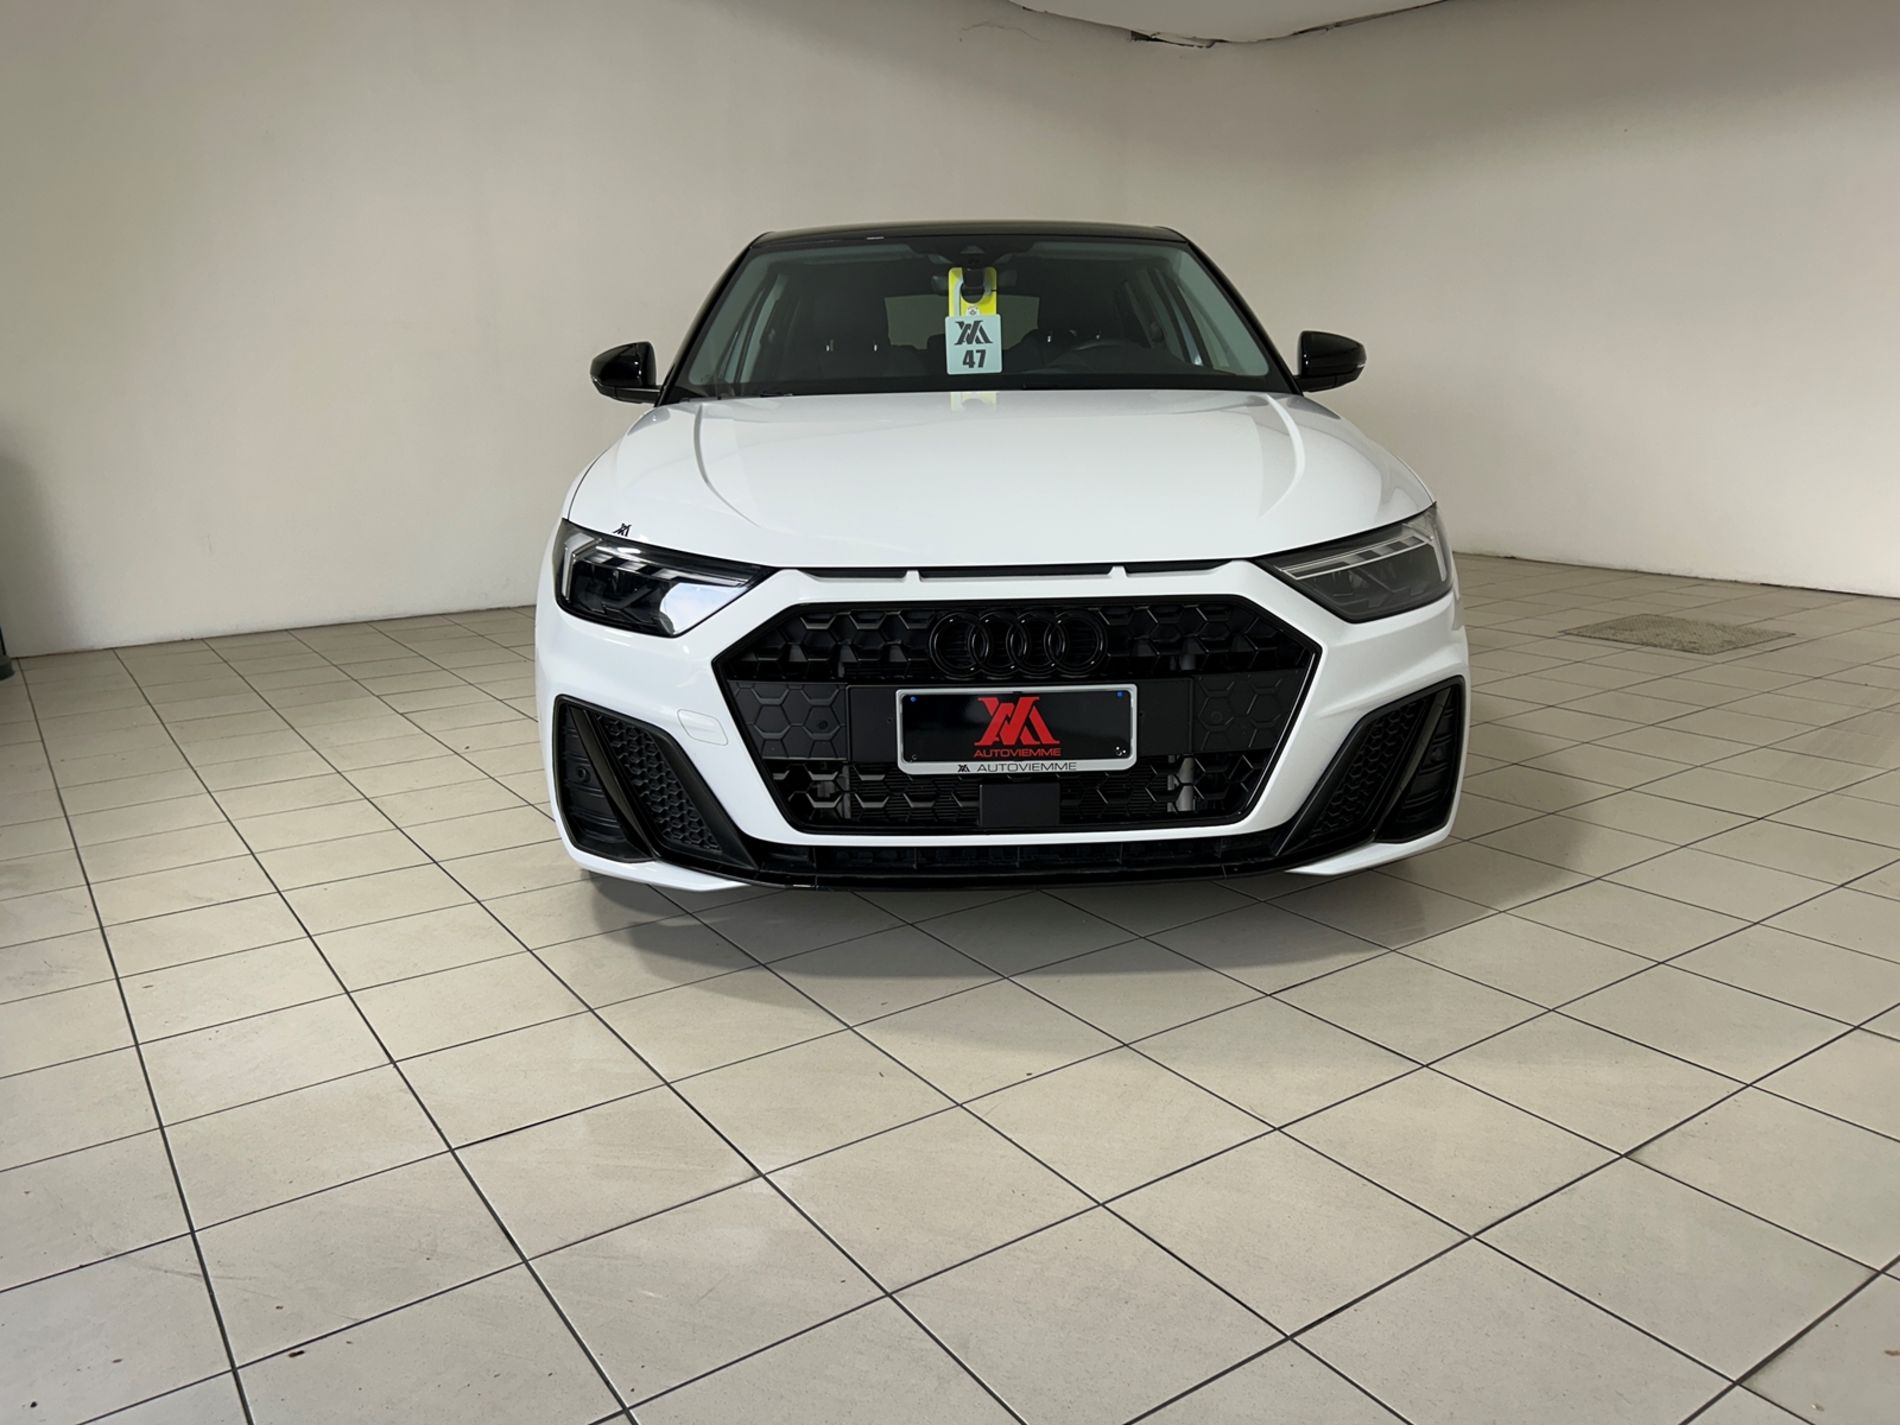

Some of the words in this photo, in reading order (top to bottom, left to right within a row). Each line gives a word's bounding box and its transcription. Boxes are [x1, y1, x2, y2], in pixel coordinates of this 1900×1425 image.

[962, 349, 987, 368] 47
[974, 748, 1061, 757] AUTOVIEMME
[977, 762, 1077, 772] AUTOVIEMME
